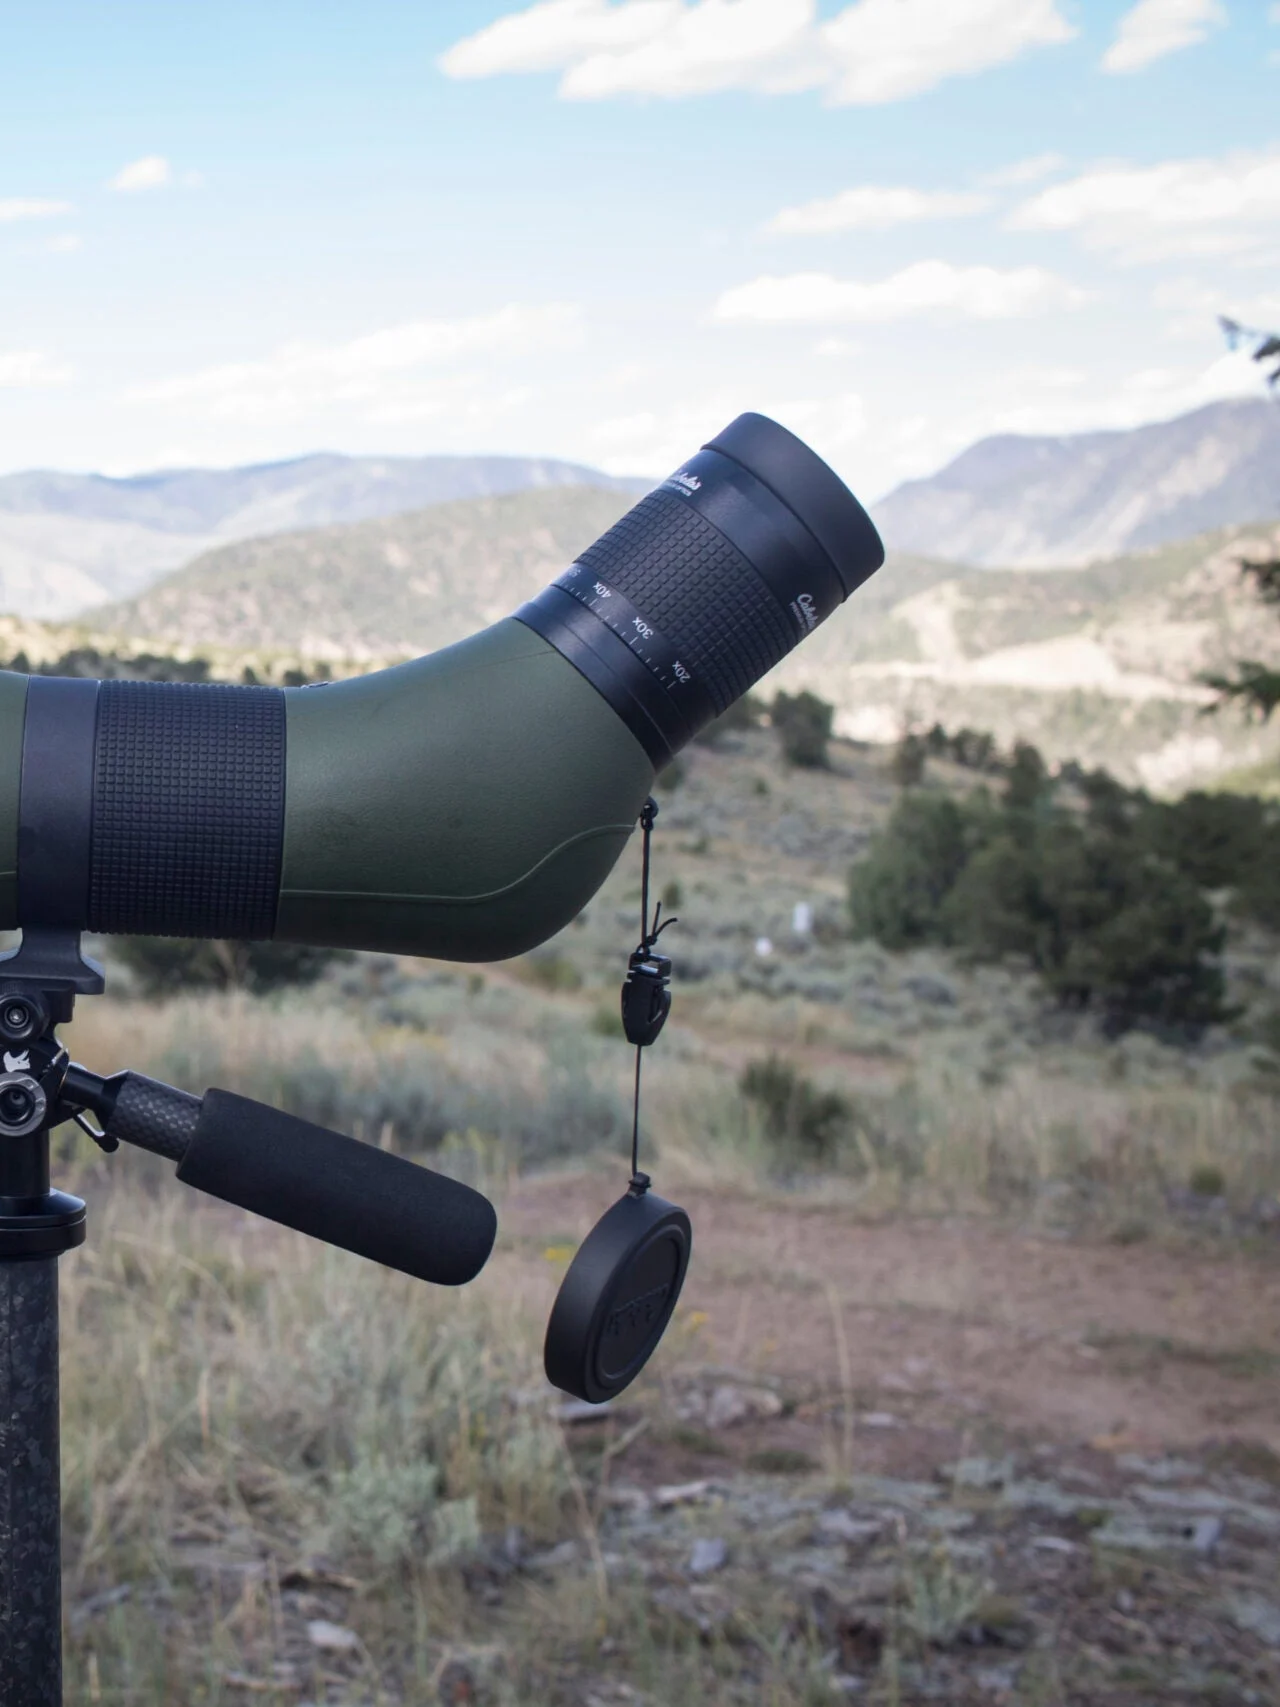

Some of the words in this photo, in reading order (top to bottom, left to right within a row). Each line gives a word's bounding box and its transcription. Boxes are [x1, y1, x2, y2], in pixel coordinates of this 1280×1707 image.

[593, 581, 612, 599] 40x
[632, 616, 654, 639] 30x
[672, 660, 691, 683] 20x
